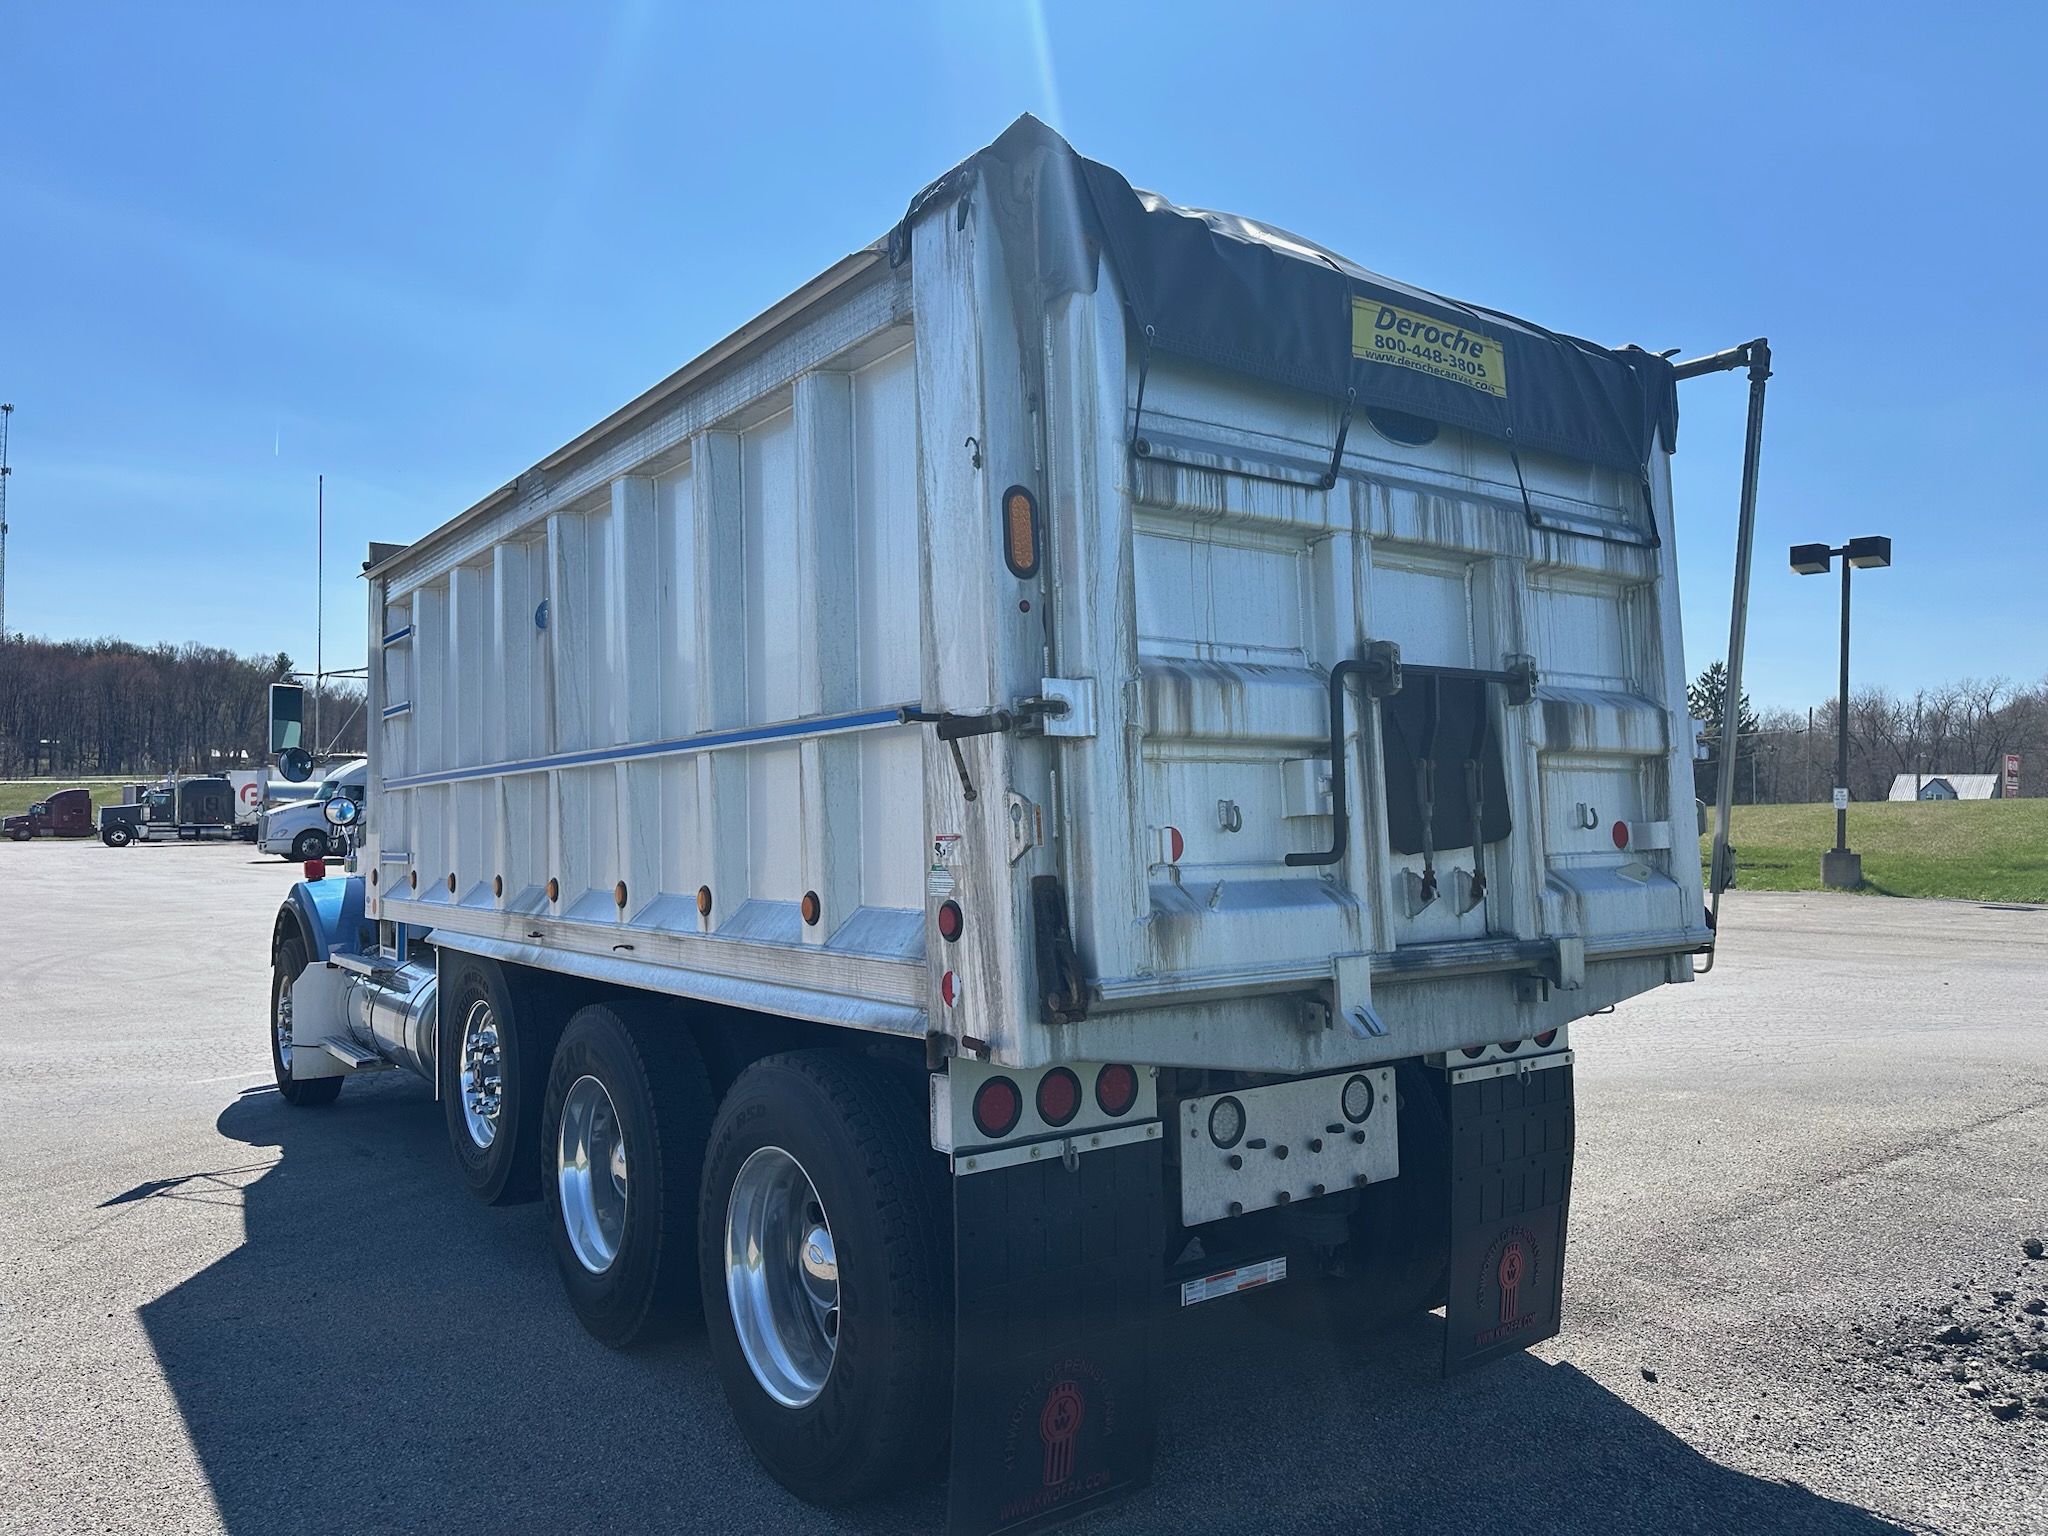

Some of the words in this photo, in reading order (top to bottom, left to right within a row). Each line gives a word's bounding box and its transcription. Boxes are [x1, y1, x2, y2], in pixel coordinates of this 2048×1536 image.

[1374, 306, 1484, 359] Deroche
[1364, 350, 1496, 393] www.derochecanvas.com
[1374, 334, 1487, 378] 800-448-3805
[735, 1104, 766, 1130] RSD
[1003, 1379, 1043, 1472] KENWORTH
[1044, 1363, 1062, 1382] OF
